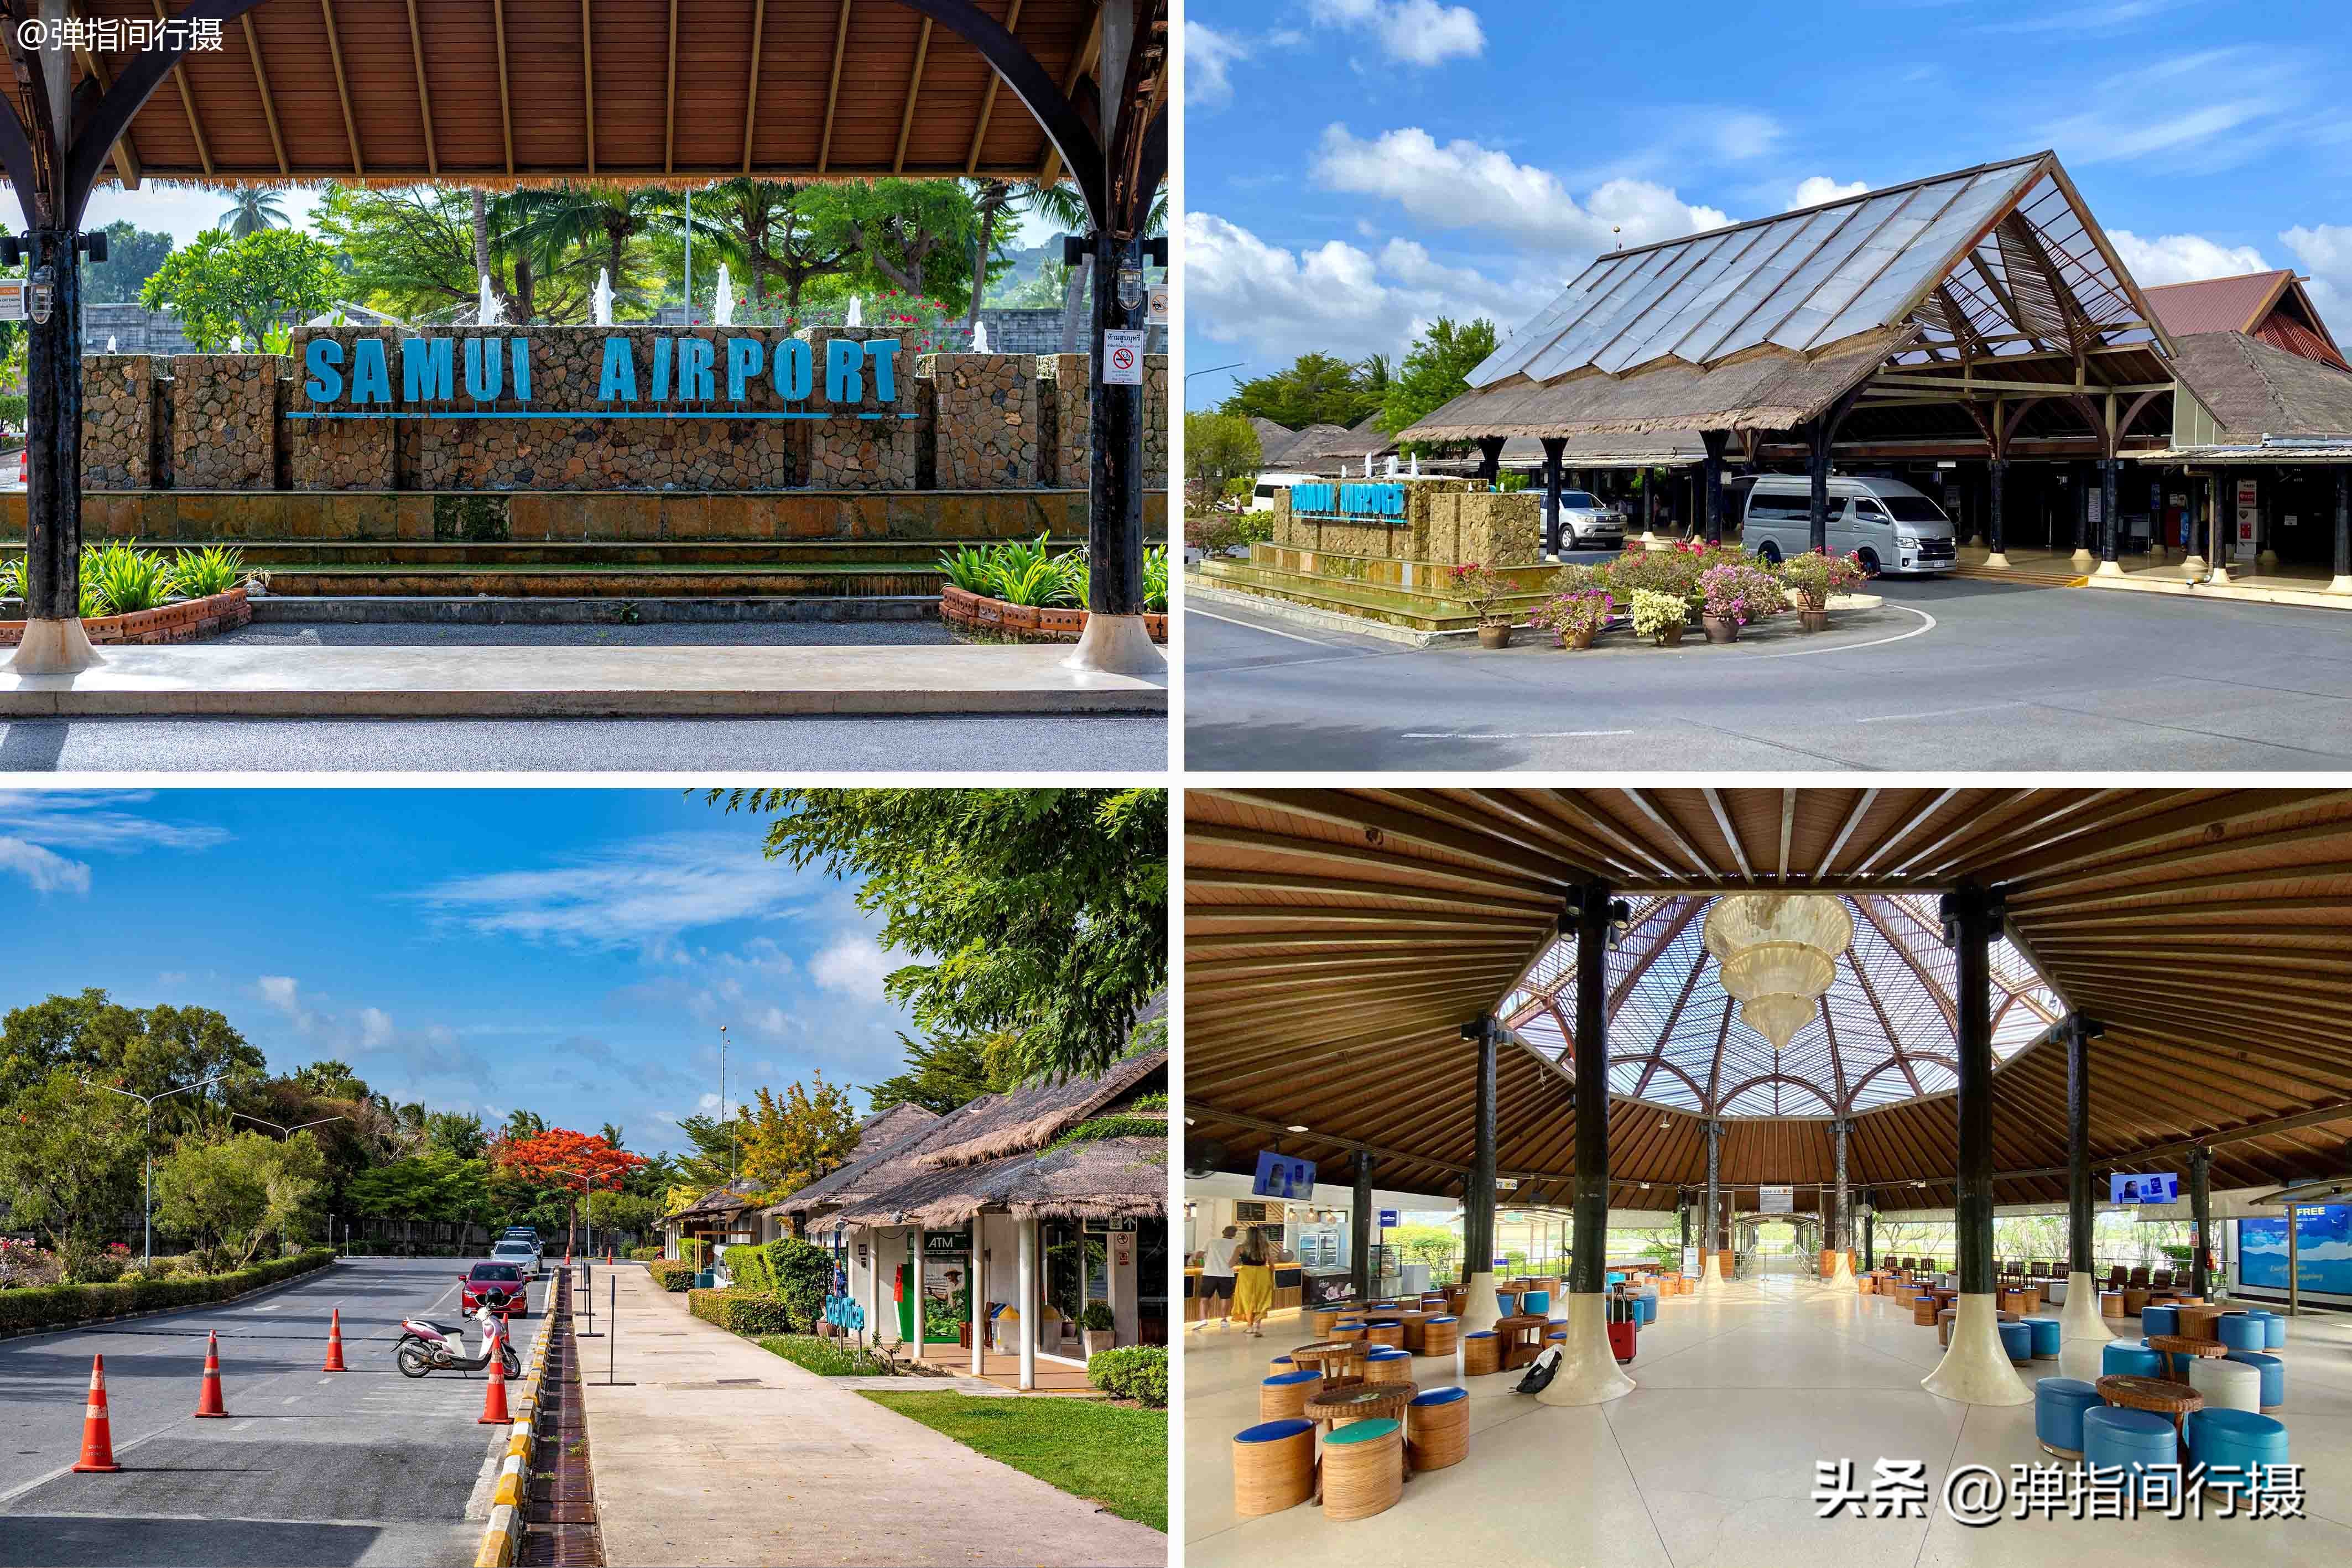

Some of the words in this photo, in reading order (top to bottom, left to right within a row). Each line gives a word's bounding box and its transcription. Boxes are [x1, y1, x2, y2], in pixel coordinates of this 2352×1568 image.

[1107, 333, 1141, 343] ห้ามสูบบุหรี่
[305, 337, 532, 403] SAMUI
[598, 337, 901, 403] AIRPORT
[2296, 1207, 2325, 1216] FREE
[929, 1237, 953, 1248] ATM
